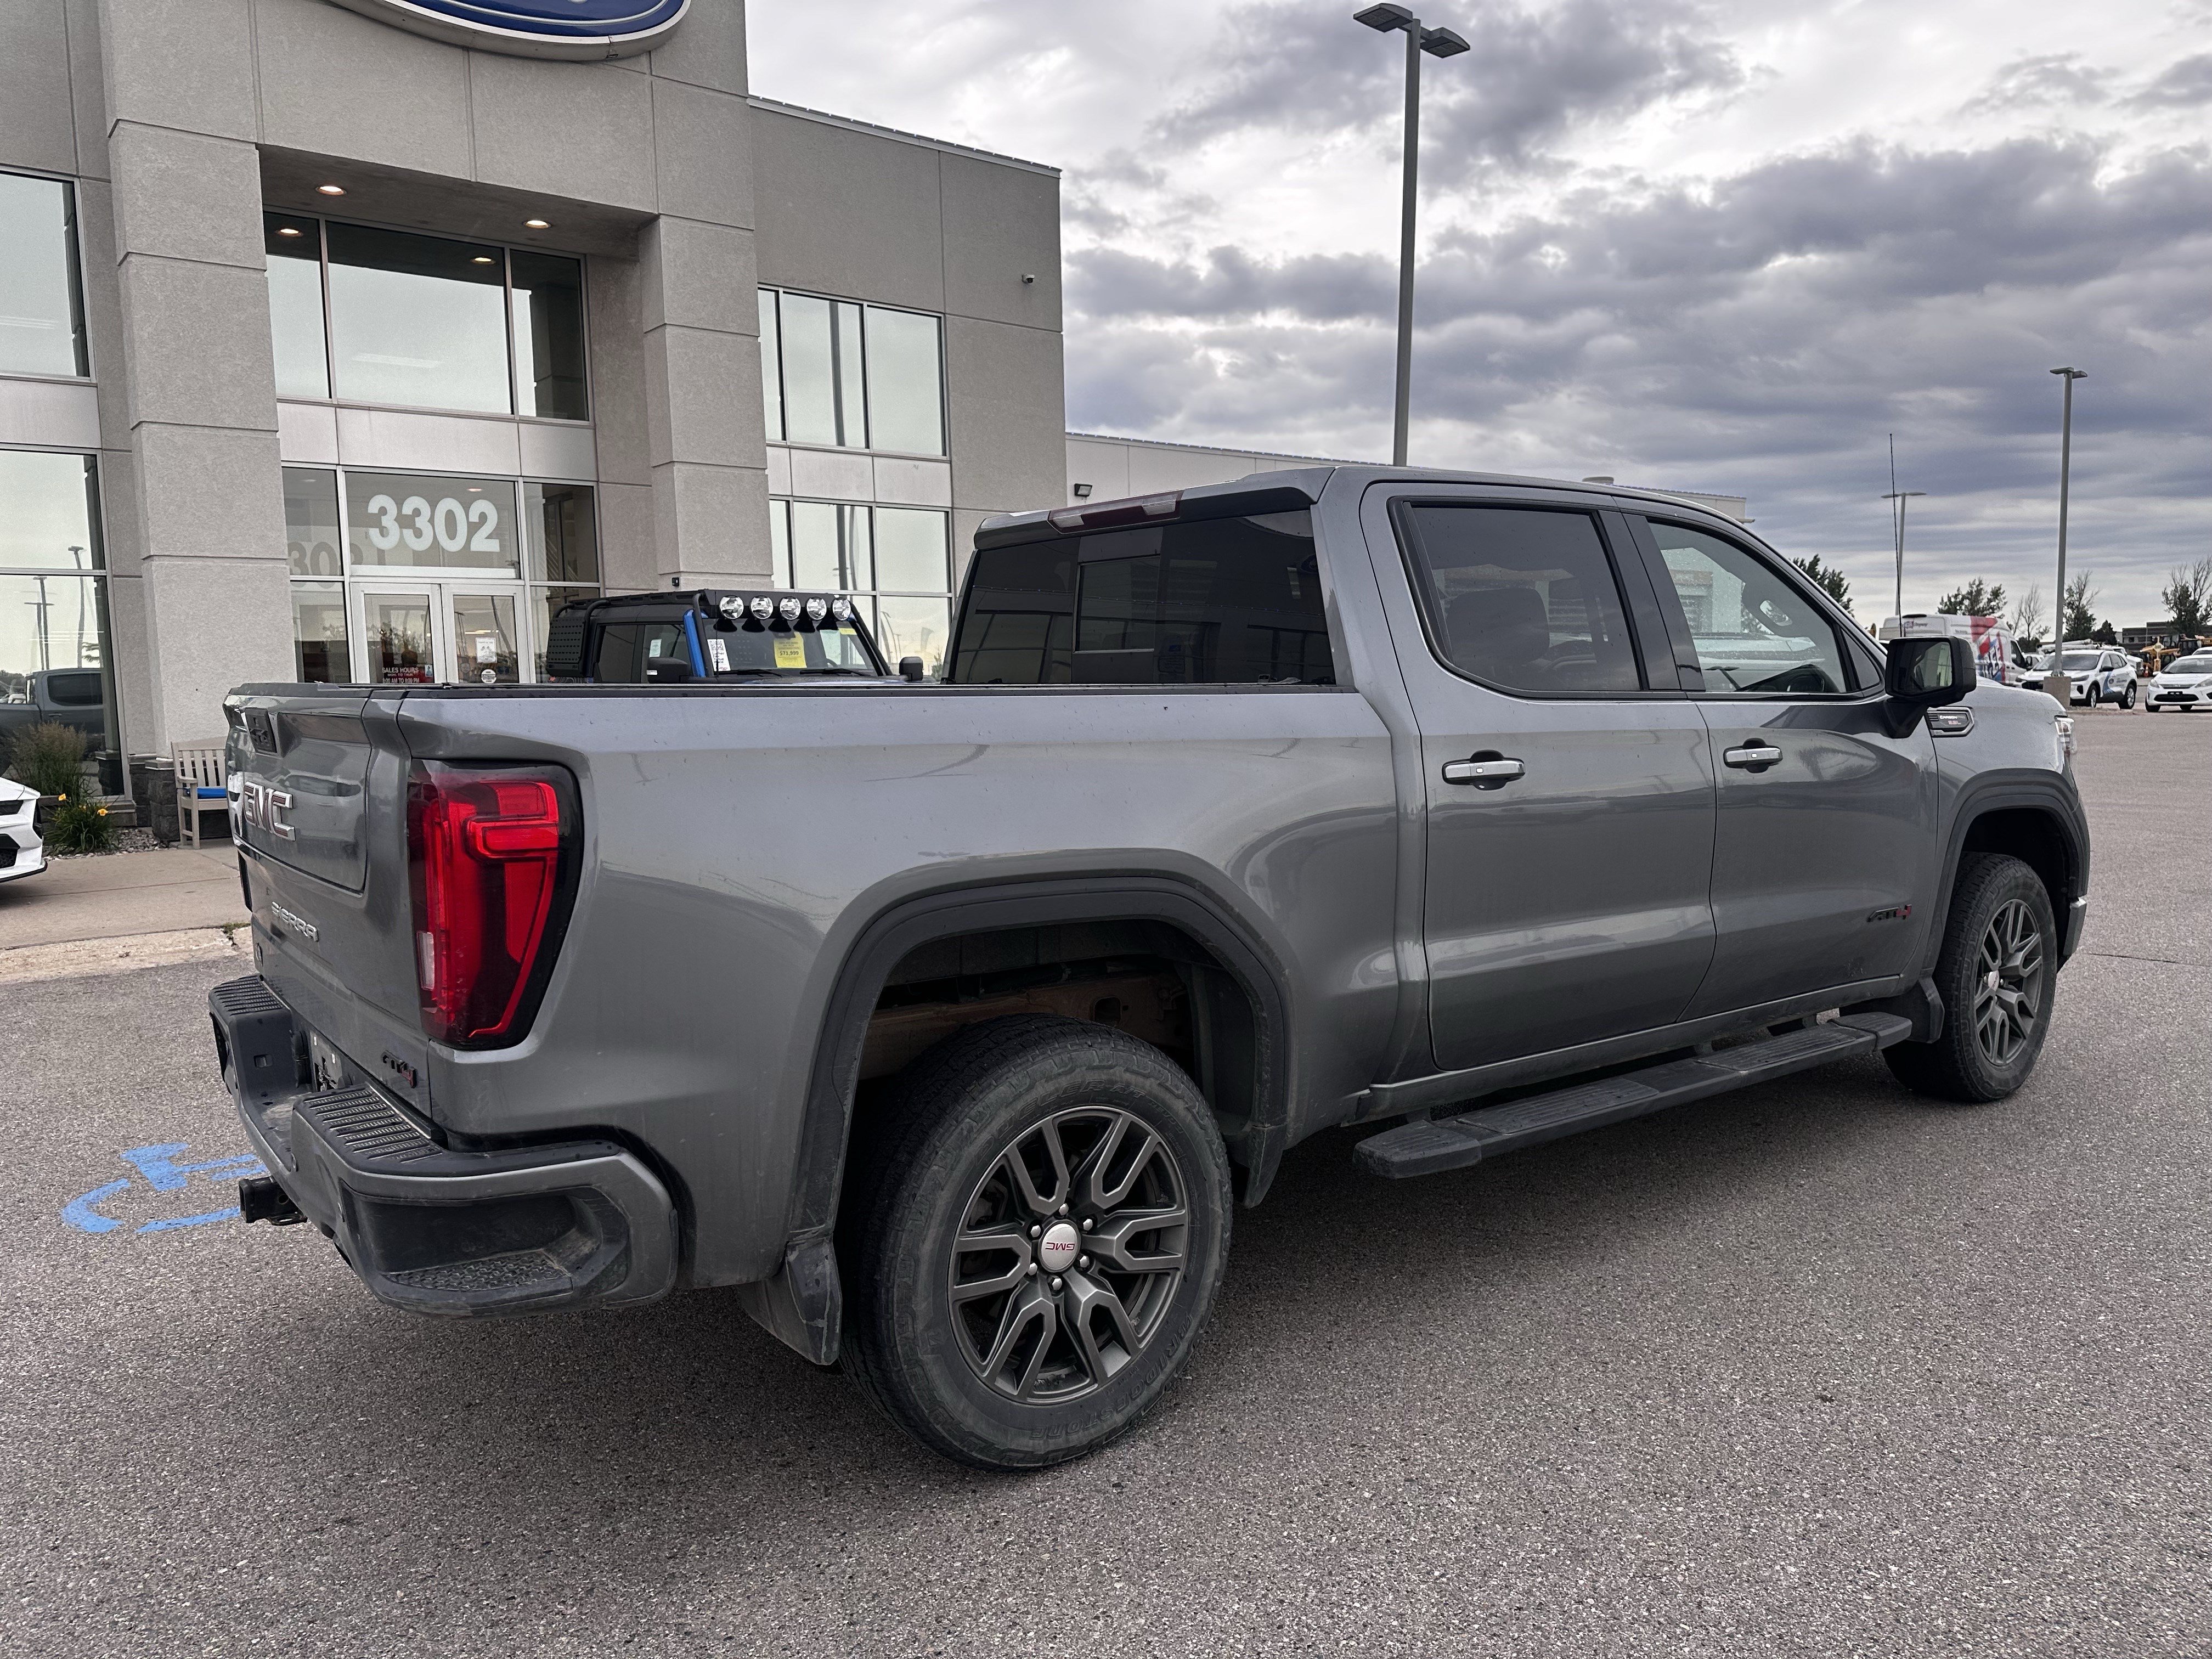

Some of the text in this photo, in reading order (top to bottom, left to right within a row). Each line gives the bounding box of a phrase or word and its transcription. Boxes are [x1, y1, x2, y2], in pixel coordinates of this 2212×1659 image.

[368, 494, 500, 552] 3302
[243, 781, 296, 842] GMC
[272, 901, 319, 943] SIERRA
[1109, 1084, 1147, 1098] A/T
[1045, 1242, 1075, 1251] GMC
[1029, 1312, 1194, 1441] BRIDGESTONE
